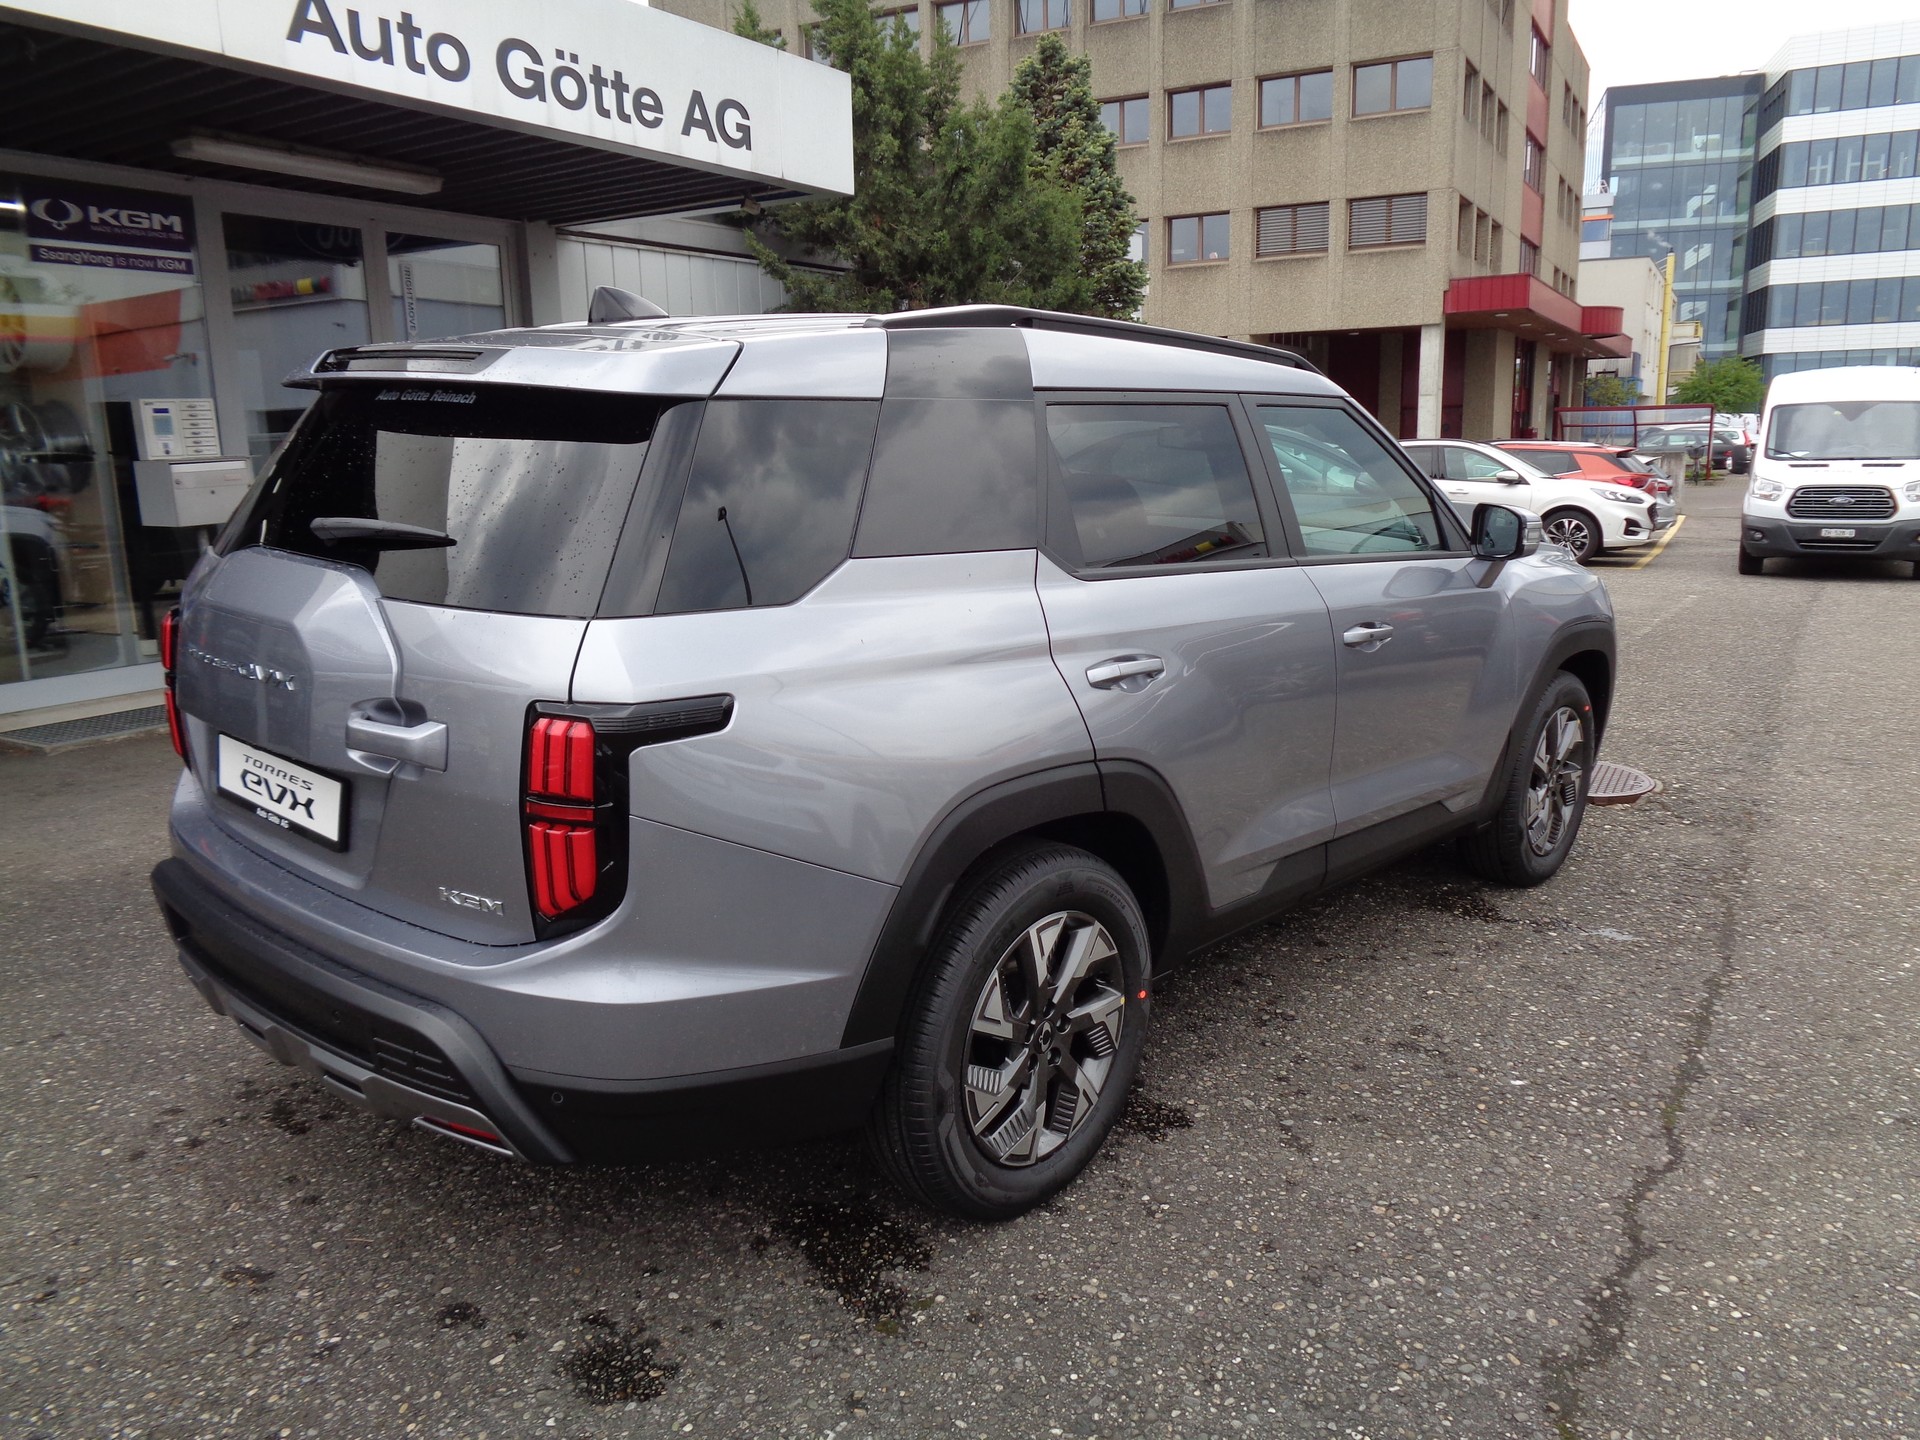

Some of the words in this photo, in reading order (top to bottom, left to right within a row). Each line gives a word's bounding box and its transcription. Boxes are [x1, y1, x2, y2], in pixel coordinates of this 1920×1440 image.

[286, 0, 471, 83] Auto
[495, 37, 664, 130] Götte
[681, 89, 752, 152] AG
[87, 205, 183, 233] KGM
[39, 248, 114, 267] SsangYong
[116, 255, 127, 266] is
[129, 257, 155, 268] now
[156, 258, 187, 271] KGM
[430, 389, 477, 404] Reinach
[242, 753, 314, 791] TORRES
[438, 886, 504, 917] KGM
